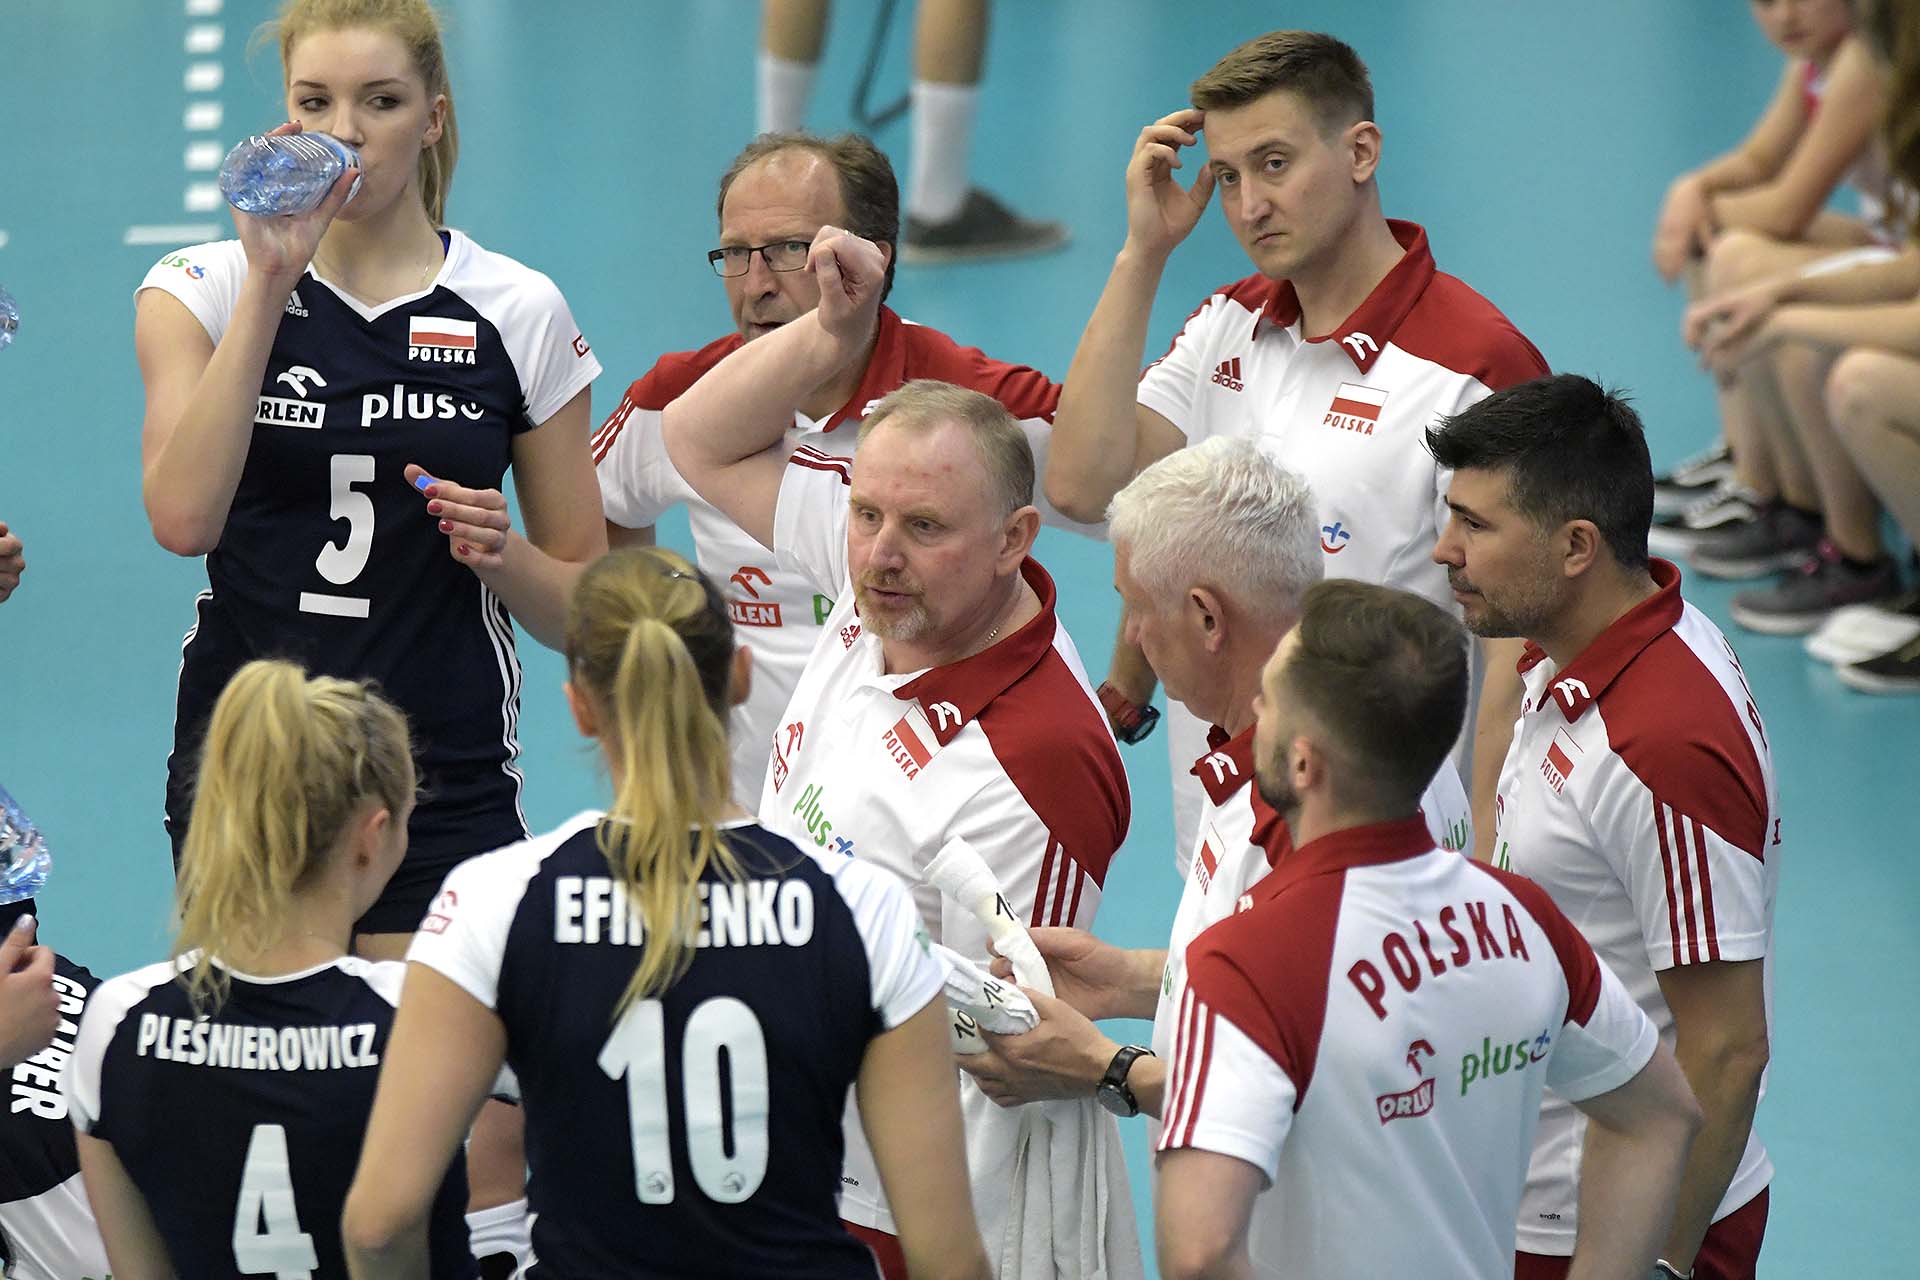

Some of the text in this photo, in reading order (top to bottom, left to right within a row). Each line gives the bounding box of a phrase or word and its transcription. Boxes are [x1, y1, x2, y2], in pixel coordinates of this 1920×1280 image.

[161, 255, 190, 268] us
[285, 304, 309, 318] idas
[408, 347, 476, 365] POLSKA
[1211, 372, 1244, 392] didas
[256, 401, 318, 424] RLEN
[361, 384, 457, 427] plus
[1323, 413, 1375, 436] POLSKA
[316, 453, 376, 585] 5
[728, 603, 777, 625] RLEN
[881, 730, 920, 781] POLSKA
[1539, 757, 1564, 796] POLSKA
[793, 784, 833, 847] plus
[555, 875, 815, 948] EFIENKO
[1347, 901, 1530, 1020] POLSKA
[137, 1014, 379, 1072] PLEŚNIEROWICZ
[954, 1009, 976, 1039] 10
[1460, 1037, 1530, 1097] plus
[597, 996, 770, 1205] 10
[1379, 1082, 1432, 1119] ORLN
[232, 1124, 319, 1280] 4
